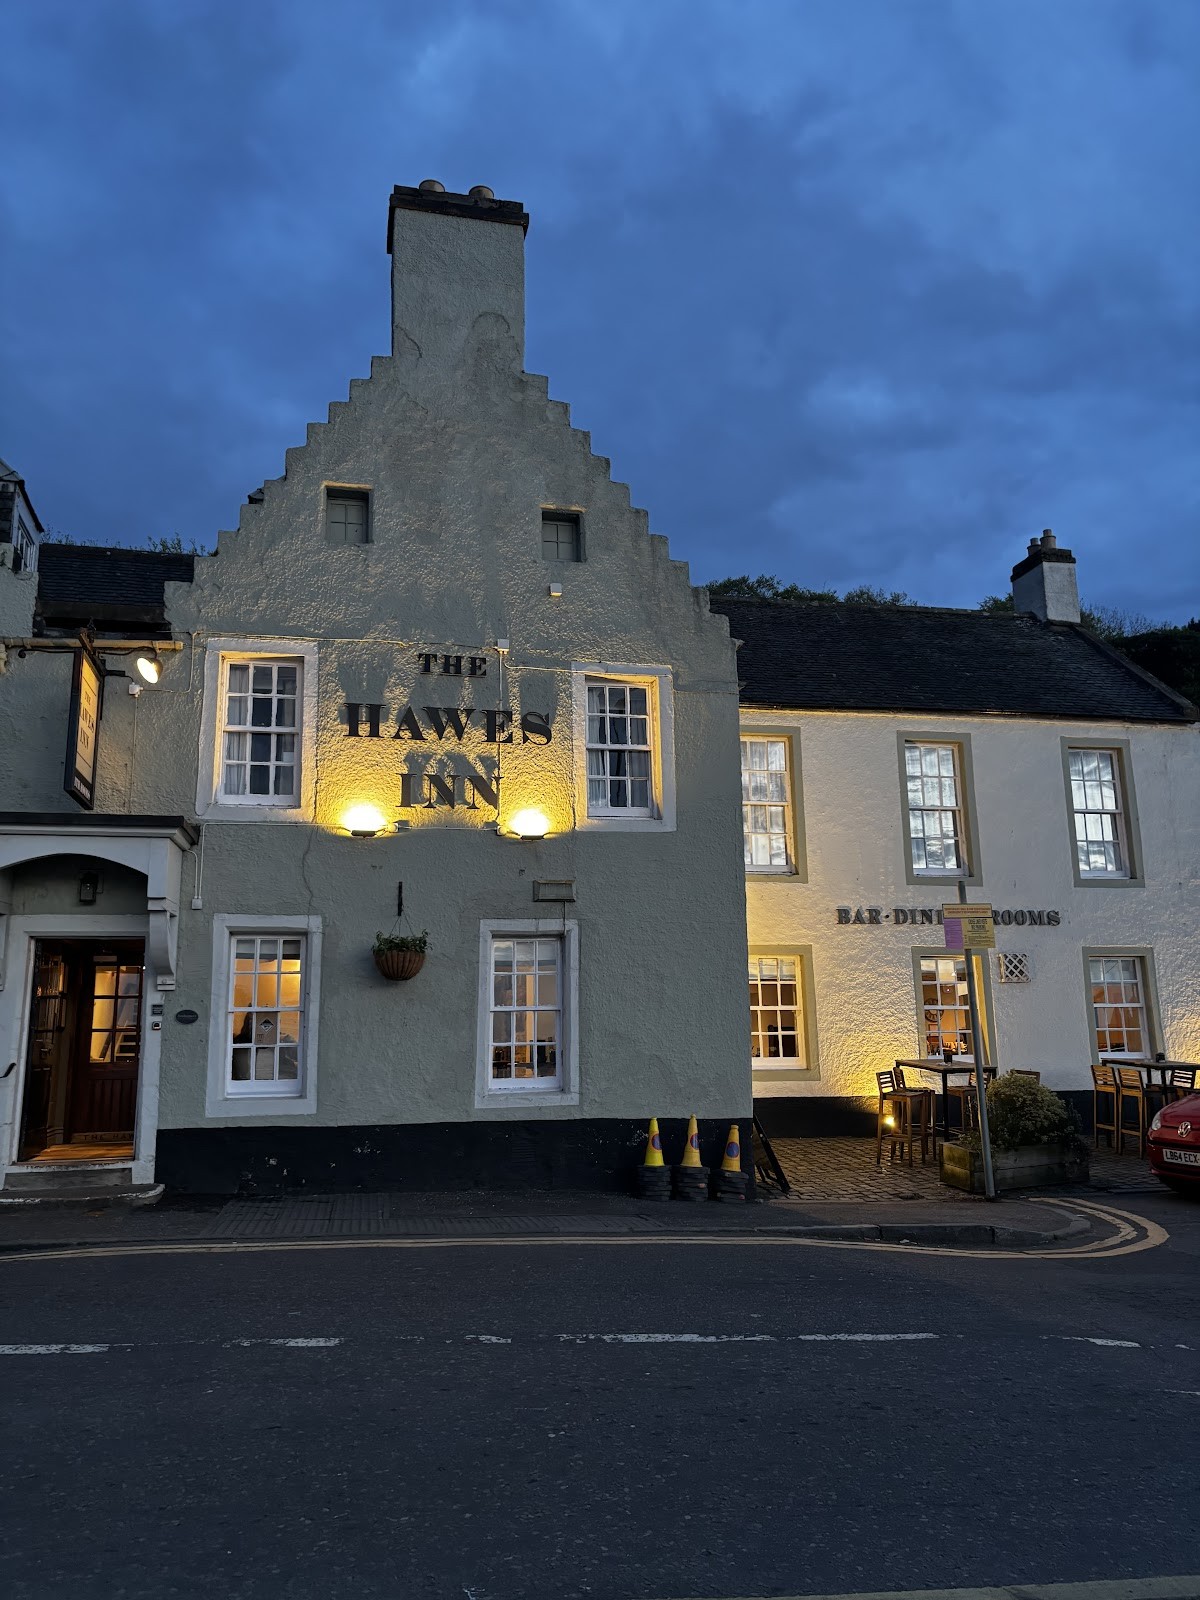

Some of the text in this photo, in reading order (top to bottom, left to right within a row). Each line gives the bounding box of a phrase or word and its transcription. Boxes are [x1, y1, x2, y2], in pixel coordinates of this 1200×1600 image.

[418, 653, 487, 678] THE
[343, 702, 553, 746] HAWES
[395, 773, 504, 810] INN
[836, 908, 882, 925] BAR
[893, 908, 943, 925] DINI
[992, 909, 1061, 926] ROOMS
